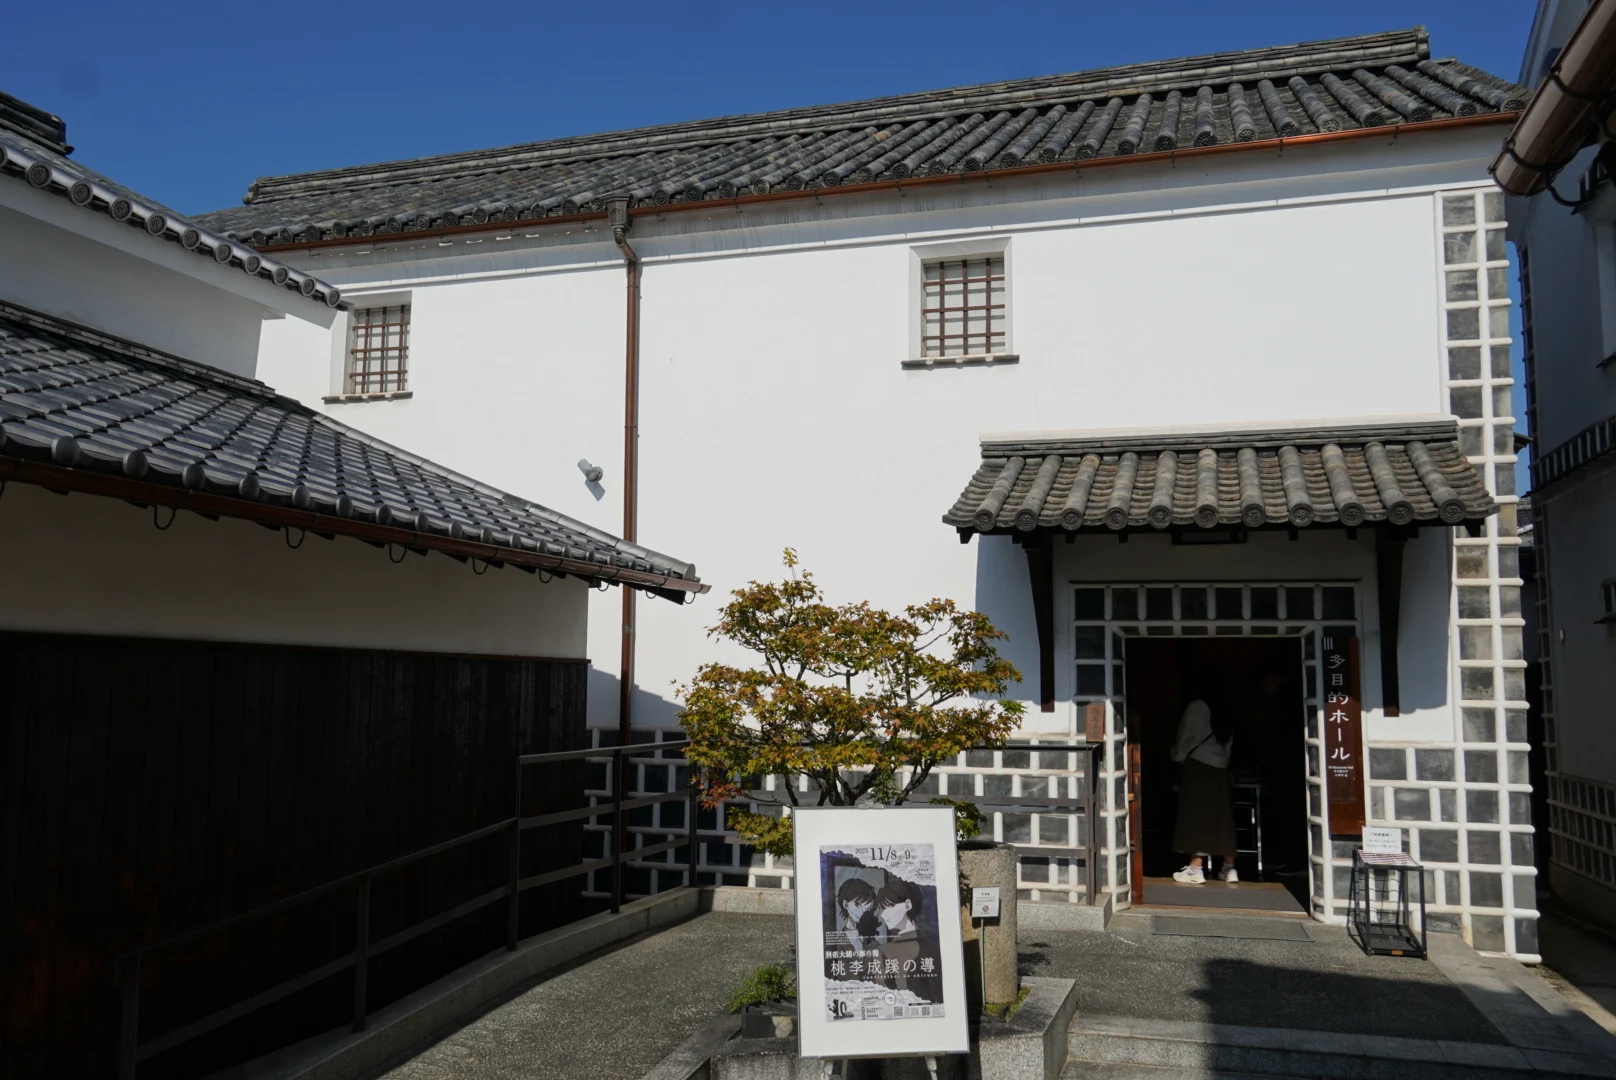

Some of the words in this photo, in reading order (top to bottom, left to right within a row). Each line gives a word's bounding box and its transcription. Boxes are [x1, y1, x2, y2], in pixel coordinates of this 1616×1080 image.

[1327, 653, 1350, 761] 多目的ホール
[831, 957, 935, 976] 桃李成蹊の導
